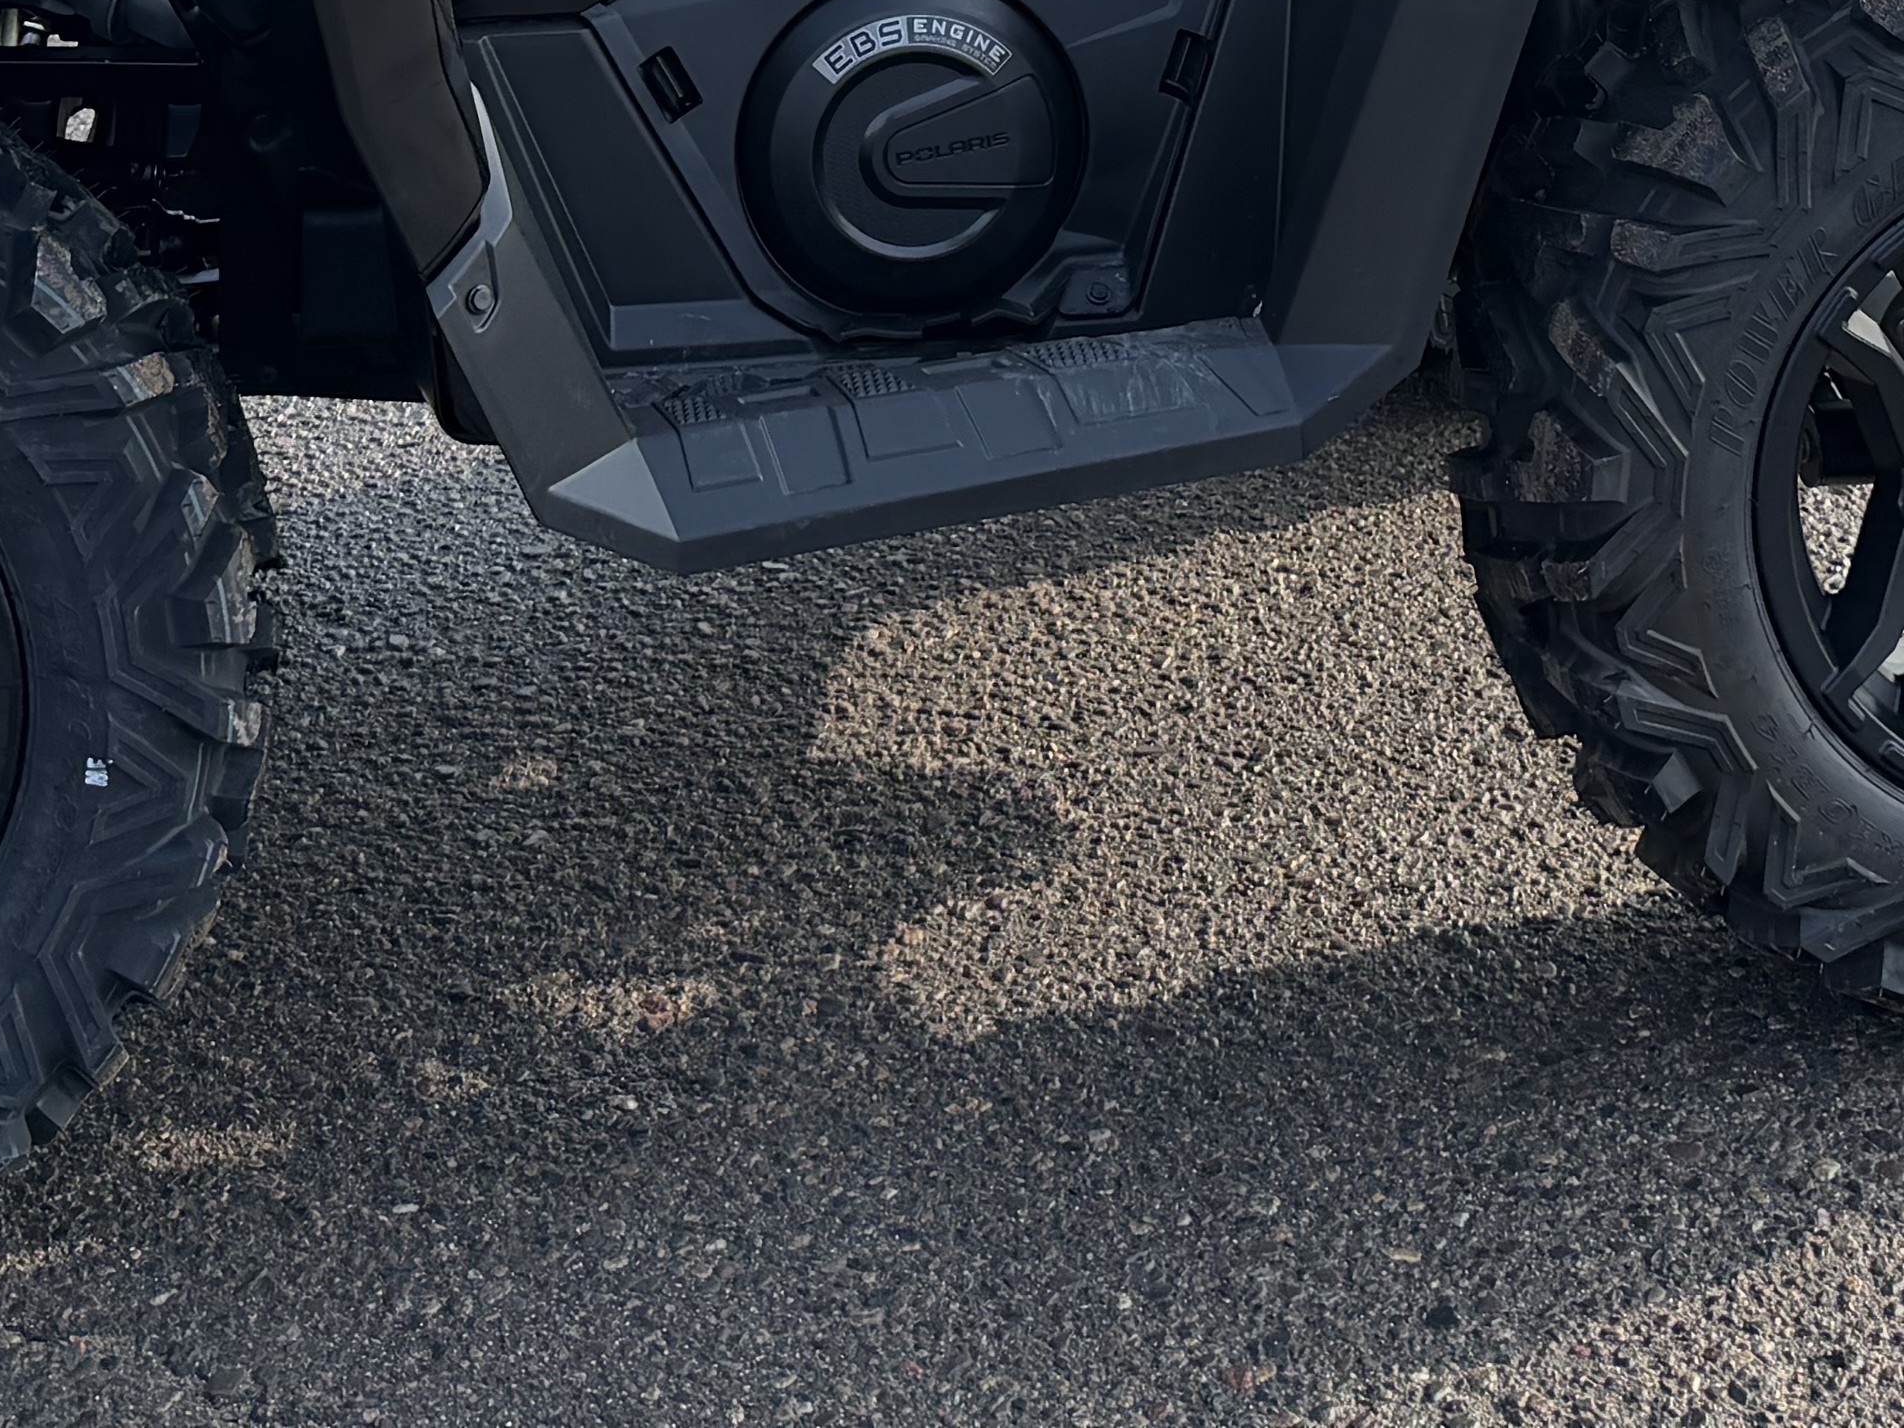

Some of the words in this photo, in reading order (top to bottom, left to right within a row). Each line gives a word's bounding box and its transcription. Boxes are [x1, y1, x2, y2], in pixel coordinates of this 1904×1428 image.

[823, 19, 904, 75] EBS
[913, 18, 1006, 63] ENGINE
[895, 132, 1011, 166] POLARIS
[1708, 226, 1839, 457] POWER
